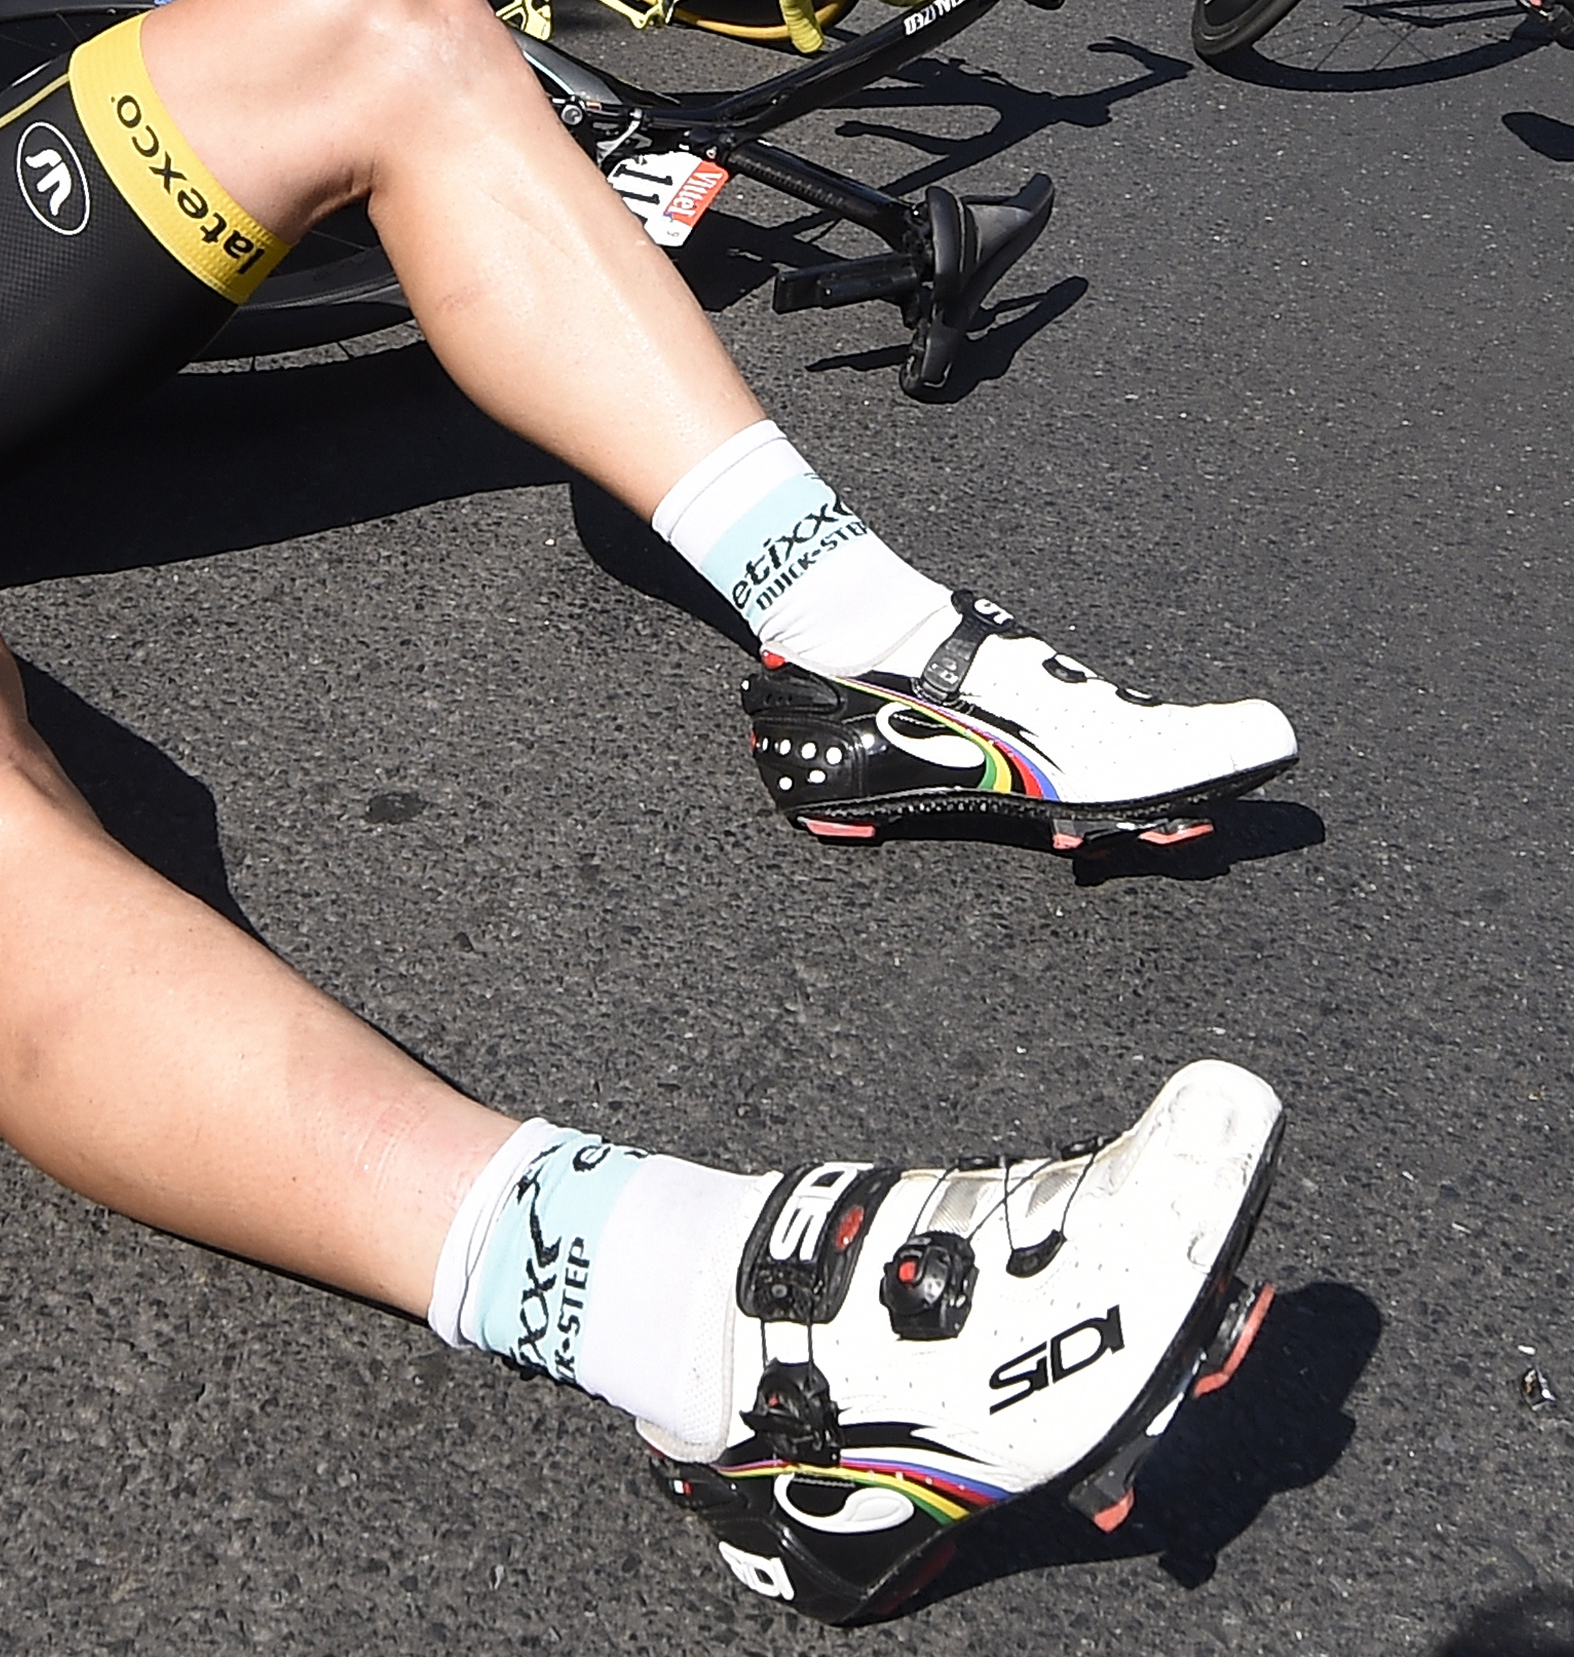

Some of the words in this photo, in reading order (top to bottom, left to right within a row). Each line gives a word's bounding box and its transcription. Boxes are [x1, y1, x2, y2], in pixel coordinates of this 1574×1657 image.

[116, 95, 265, 275] latexco
[612, 163, 674, 206] 11
[665, 171, 724, 218] Vittel
[732, 503, 839, 610] etixx
[988, 1304, 1125, 1415] SIDI
